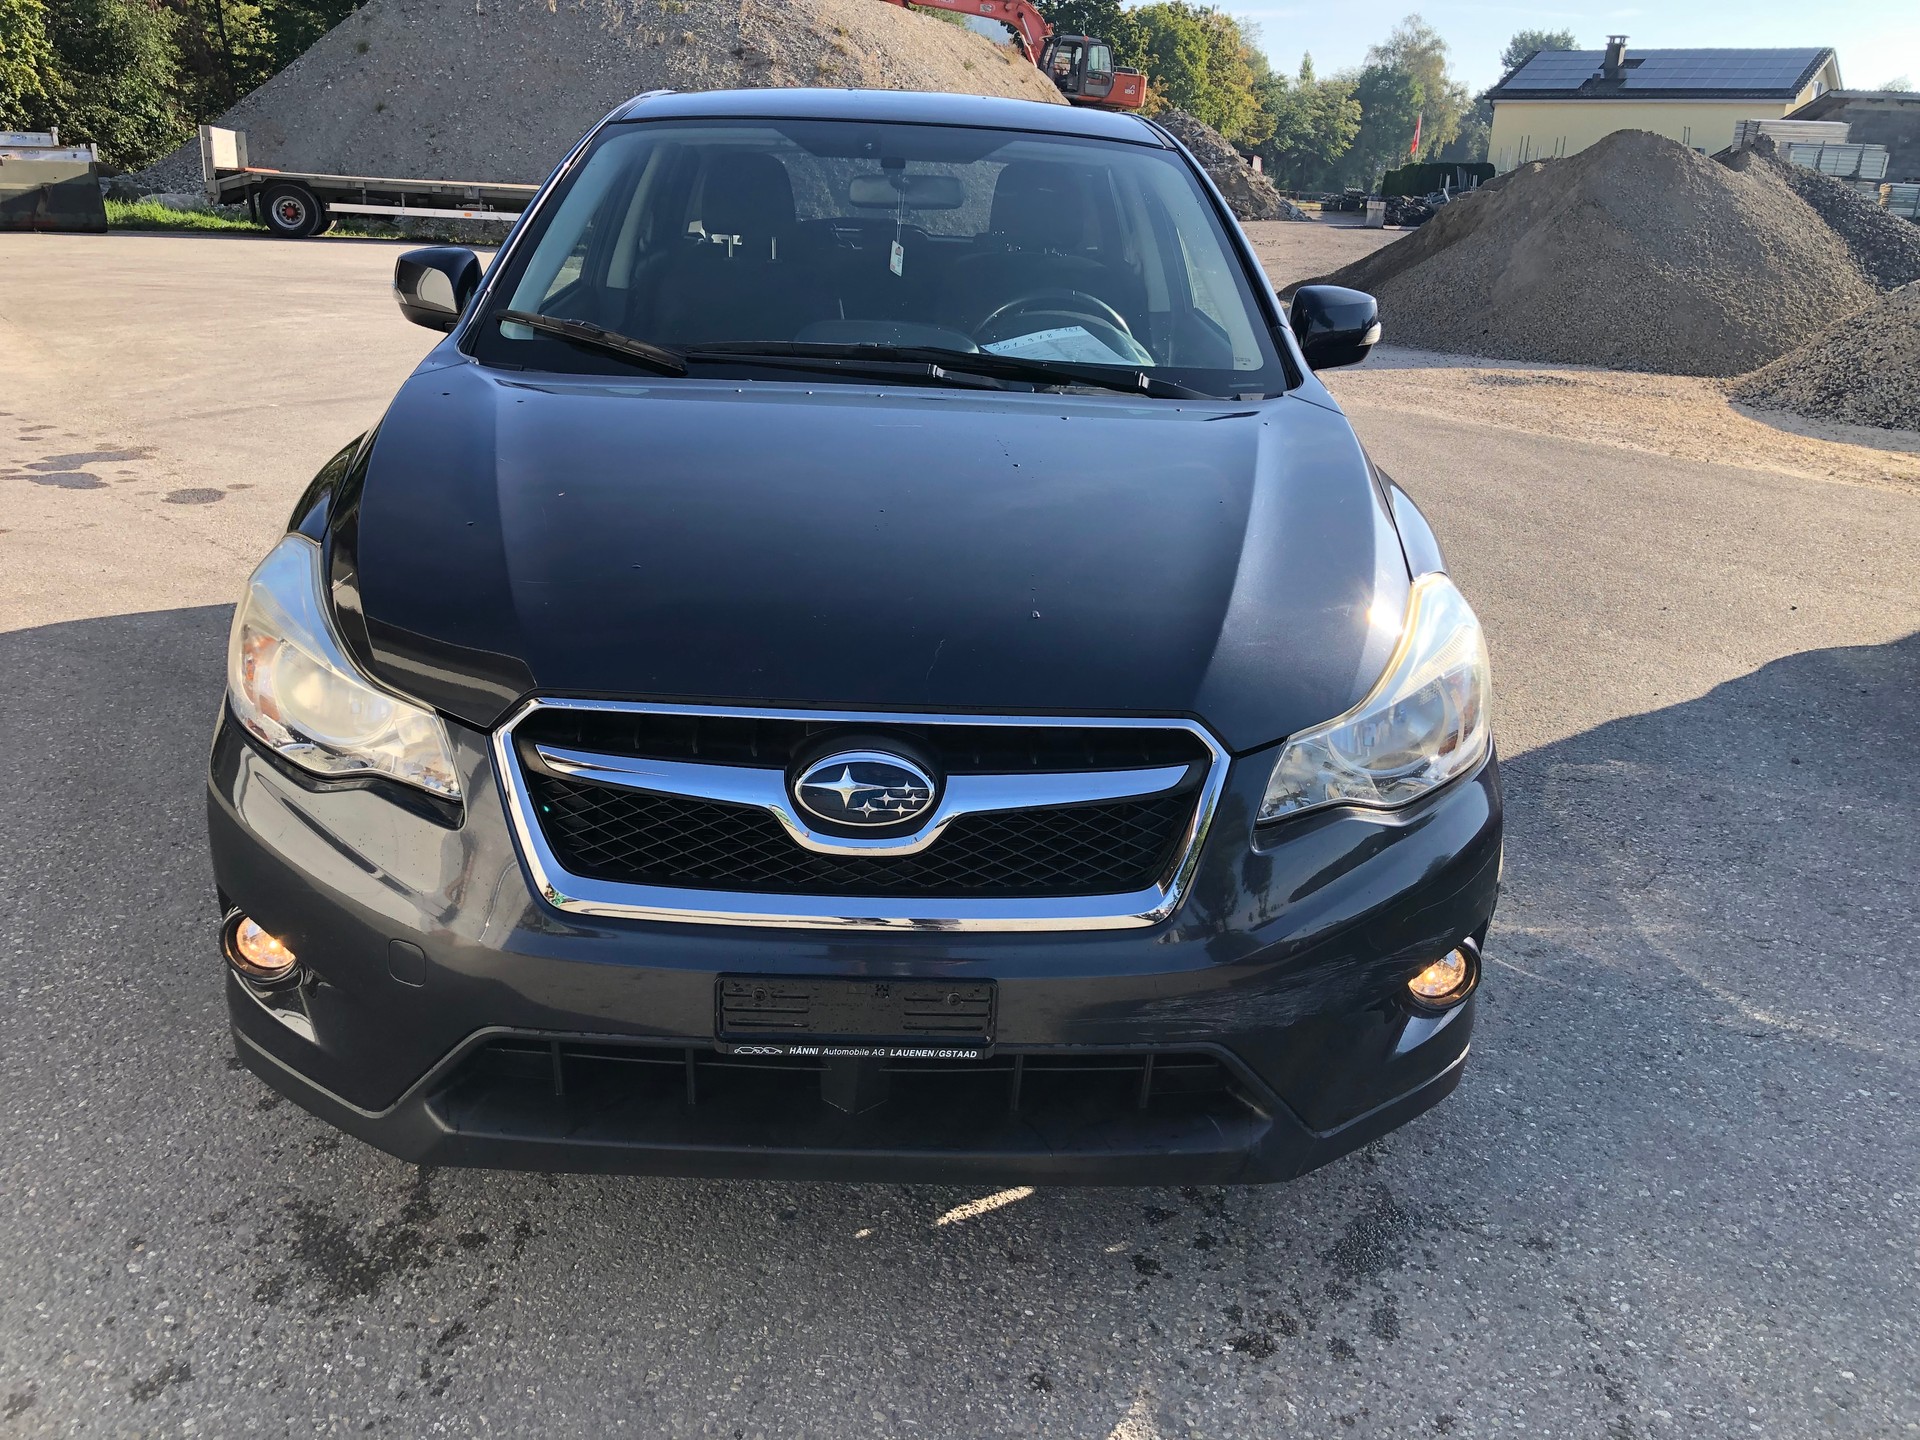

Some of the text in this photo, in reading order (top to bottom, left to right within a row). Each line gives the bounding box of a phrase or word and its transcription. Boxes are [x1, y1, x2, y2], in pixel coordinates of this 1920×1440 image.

[789, 1045, 977, 1058] HÄNNI Automobile AG LAUENEN/GSTAAD
